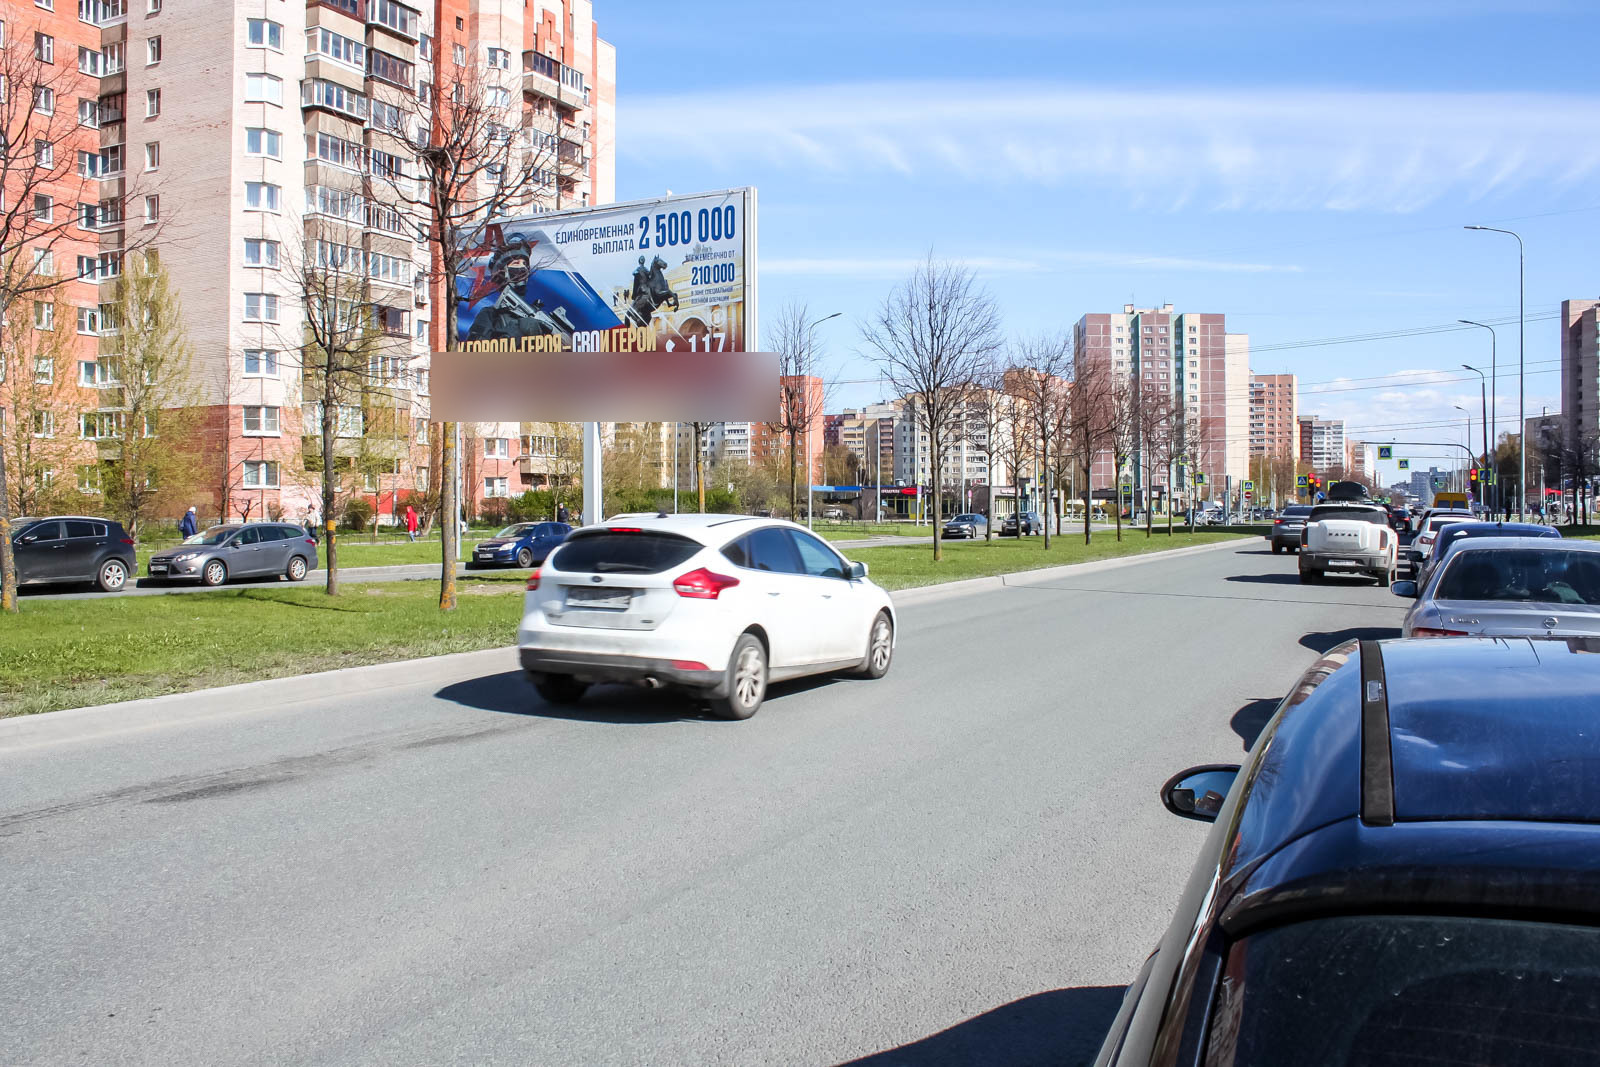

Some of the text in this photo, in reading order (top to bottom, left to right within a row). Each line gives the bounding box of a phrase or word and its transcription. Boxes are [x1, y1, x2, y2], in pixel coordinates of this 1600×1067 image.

[555, 223, 635, 244] ЕДИНОВРЕМЕННАЯ
[639, 205, 735, 249] 2 500 000
[592, 239, 635, 255] ВЫПЛАТА
[691, 263, 735, 285] 210 000
[572, 330, 609, 352] СВОИ
[612, 326, 657, 352] ГЕРОИ
[688, 333, 726, 352] 117
